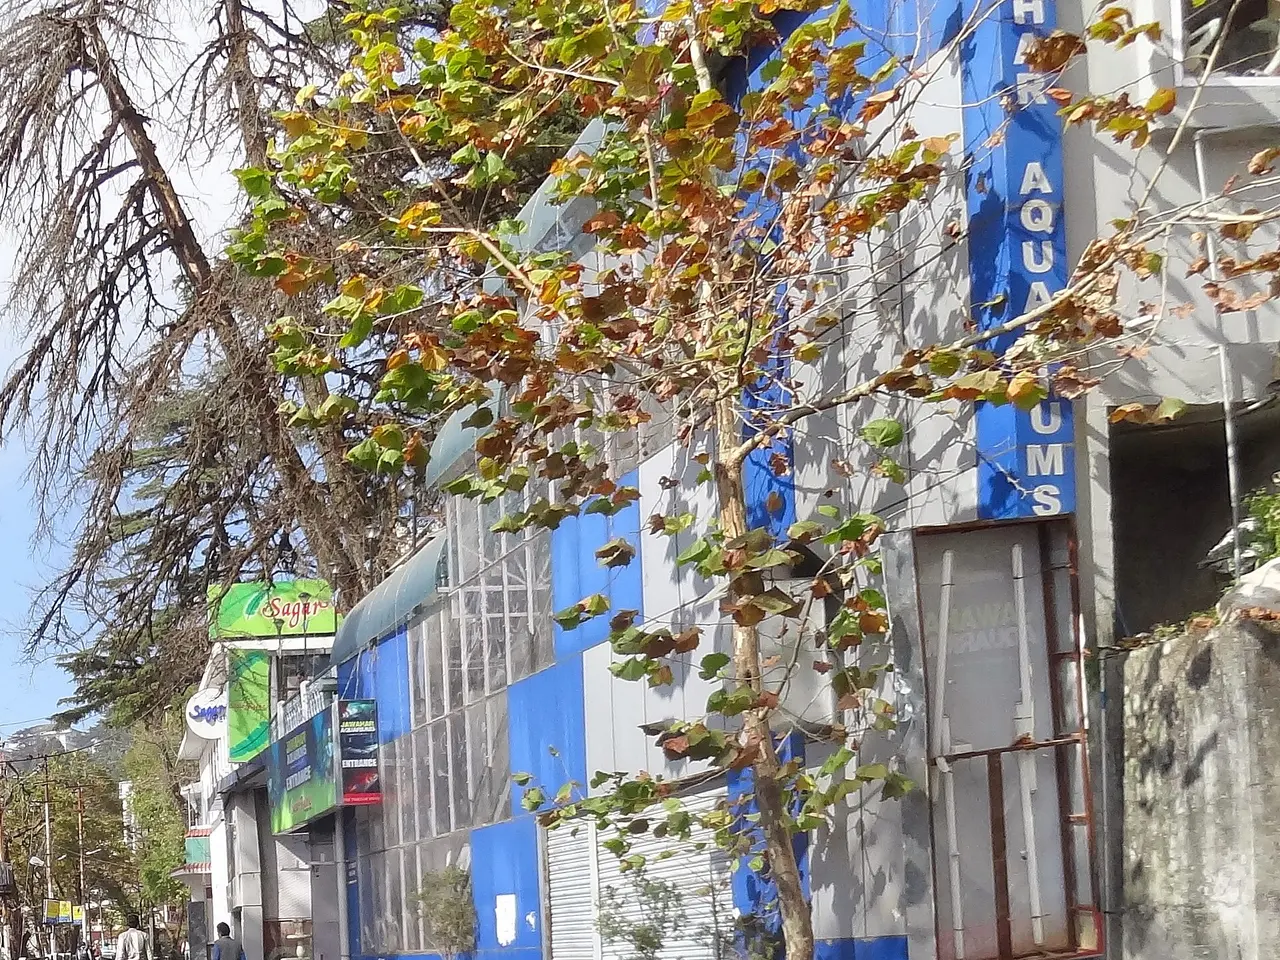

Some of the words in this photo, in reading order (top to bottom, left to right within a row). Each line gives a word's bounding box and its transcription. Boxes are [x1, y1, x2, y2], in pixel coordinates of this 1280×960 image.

[1019, 161, 1064, 517] AQUAIUMS
[262, 597, 328, 628] Sagar
[342, 759, 377, 767] ENTRANCE
